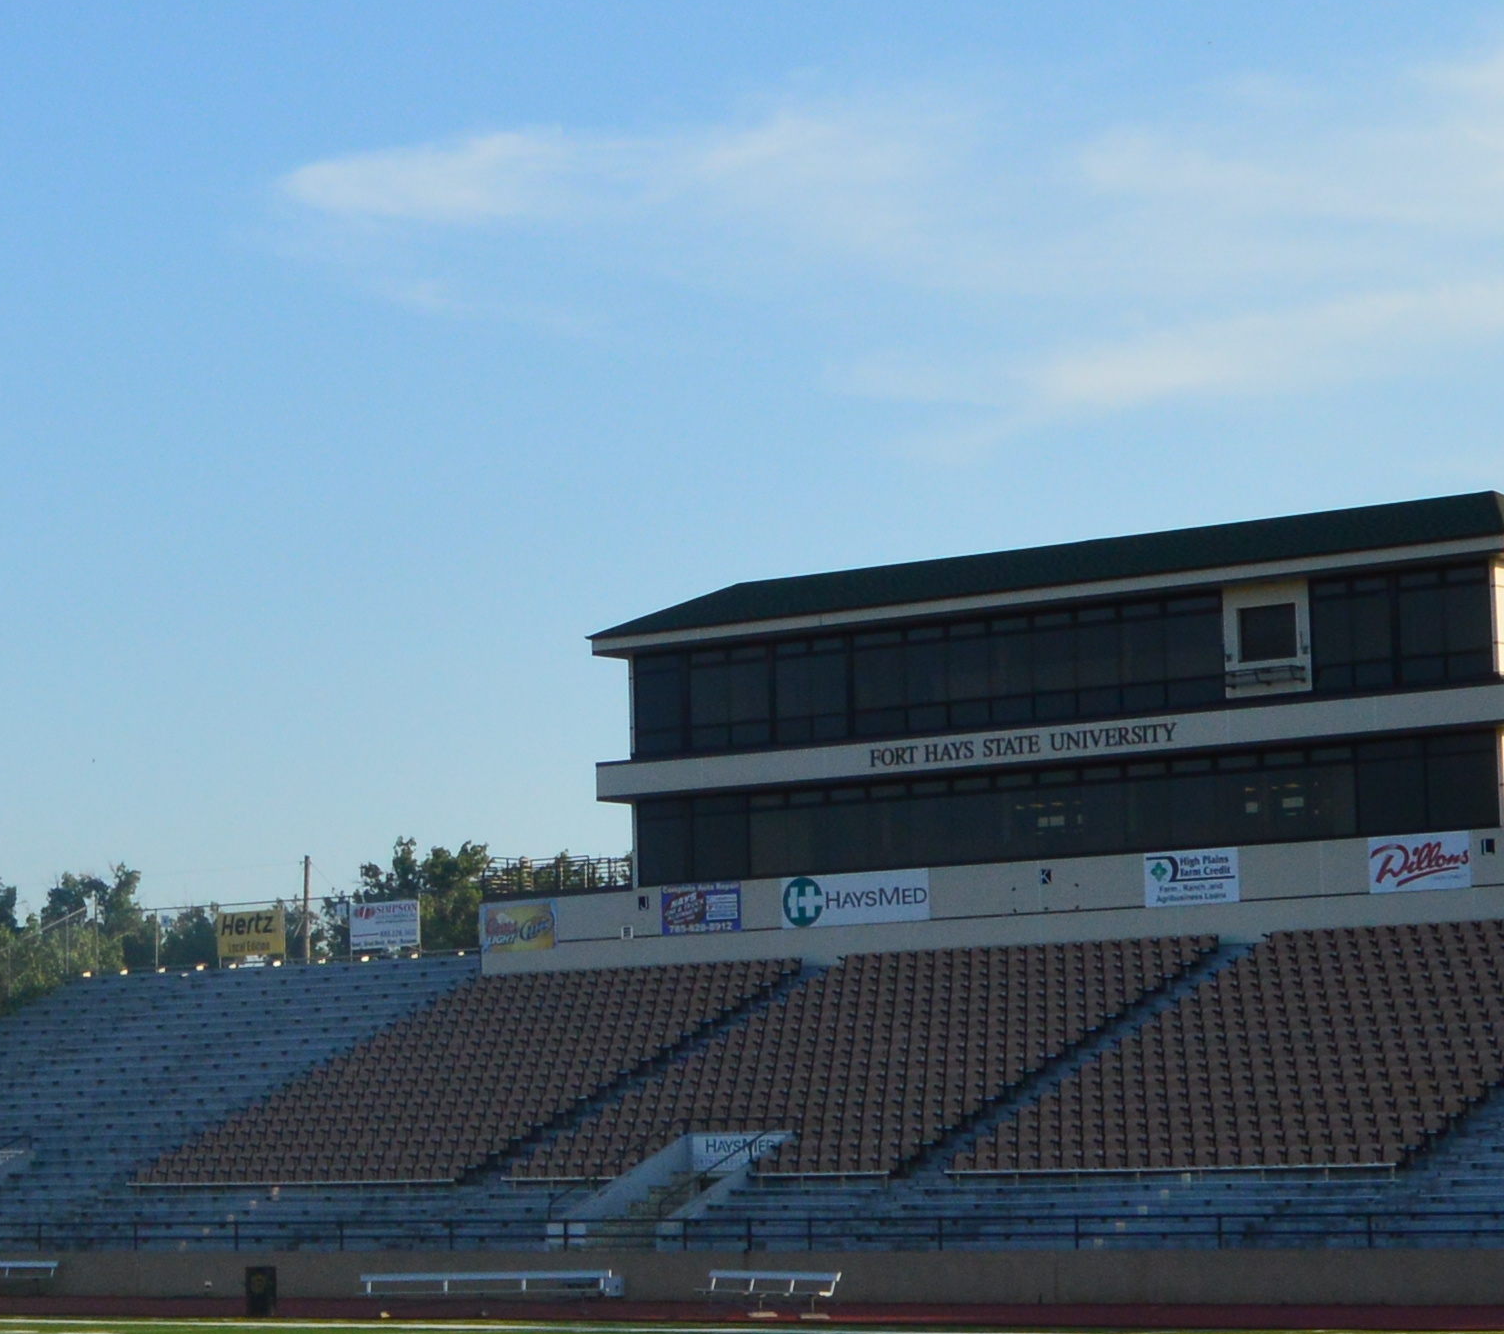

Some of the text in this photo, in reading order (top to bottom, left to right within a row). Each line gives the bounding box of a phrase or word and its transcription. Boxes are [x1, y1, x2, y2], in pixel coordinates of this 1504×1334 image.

[870, 722, 1177, 767] FORT HAYS STATE UNIVERSITY
[1179, 855, 1229, 867] High Plains
[1203, 865, 1231, 875] Credit
[1370, 841, 1469, 884] Dillons
[825, 887, 927, 909] HAYSMED
[221, 912, 274, 936] Hertz
